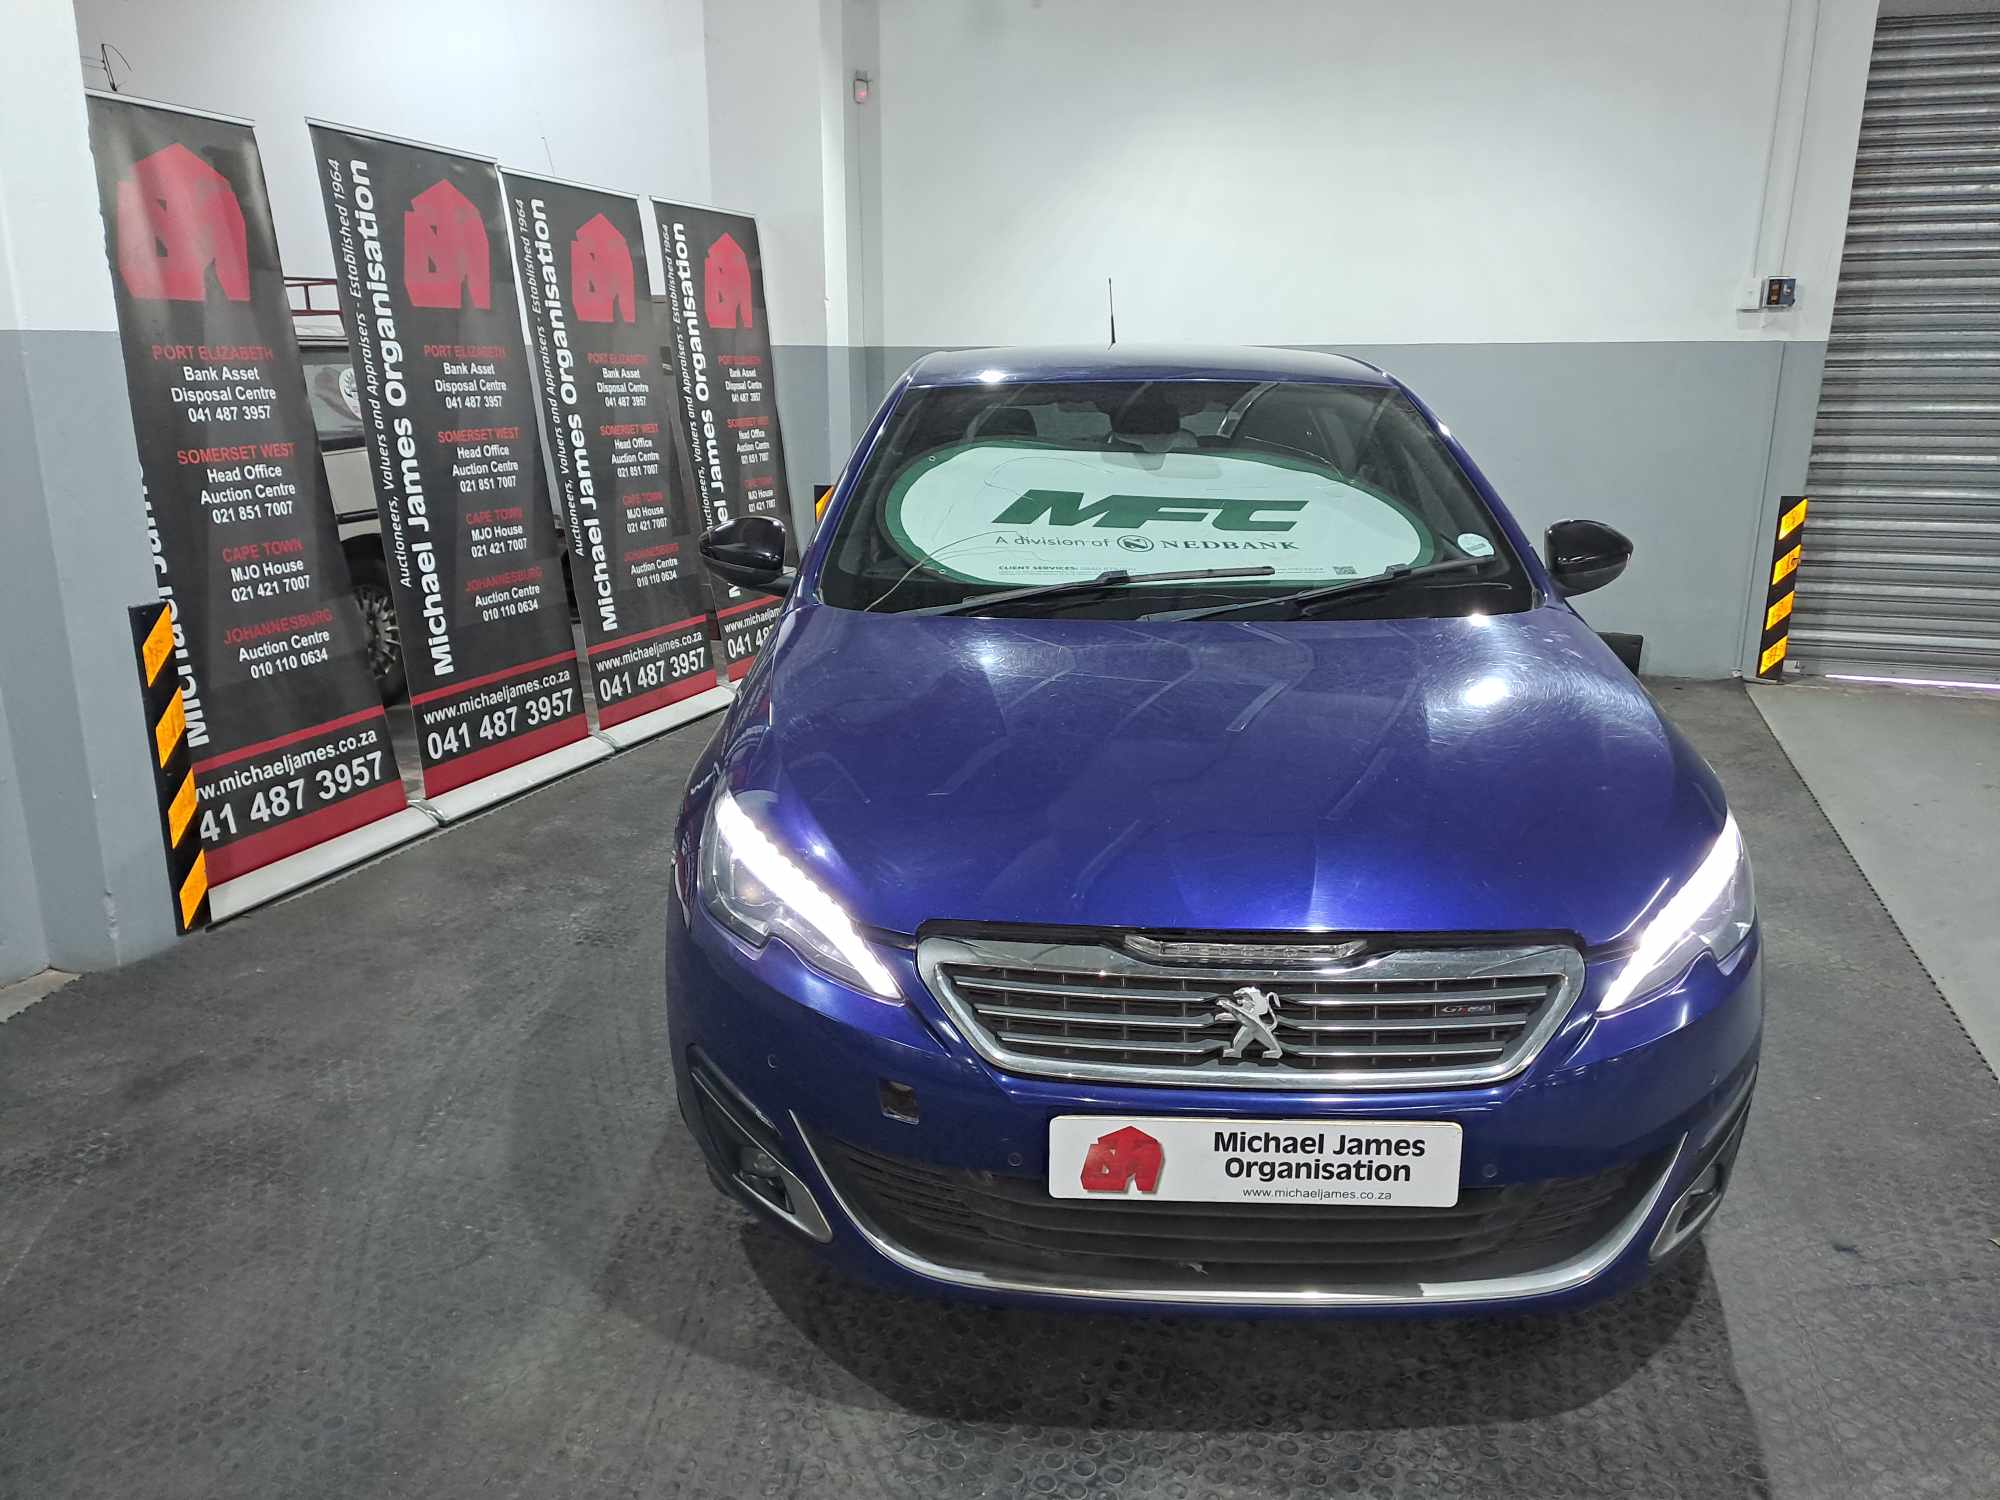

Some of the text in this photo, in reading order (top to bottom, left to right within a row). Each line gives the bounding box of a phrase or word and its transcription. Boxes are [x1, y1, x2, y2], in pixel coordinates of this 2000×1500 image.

[152, 345, 273, 361] PORT ELIZABETH
[673, 223, 725, 493] James Organisation
[677, 333, 693, 394] Appraisers
[183, 366, 259, 381] Bank Asset
[328, 158, 412, 588] Auctioneers, Valuers and Appraisers Established 1964
[443, 362, 495, 375] Bank Asset
[515, 198, 584, 556] Auctioneers, Valuers and Appraisers Established 1964
[171, 386, 276, 404] Disposal Centre
[434, 379, 507, 394] Disposal Centre
[188, 405, 271, 422] 041 487 3957
[445, 395, 502, 409] 041 487 3957
[686, 396, 697, 418] and
[350, 159, 455, 677] Michael James Organisation
[531, 198, 618, 632] Michael James Organisation
[437, 429, 493, 443] SOMERSET
[690, 421, 702, 463] Valuers
[177, 442, 296, 464] SOMERSET WEST
[456, 444, 510, 459] Head Office
[207, 464, 282, 483] Head Office
[452, 460, 519, 477] Auction Centre
[201, 483, 296, 505] Auction Centre
[460, 475, 517, 493] 021 851 7007
[212, 501, 293, 524] 021 851 7007
[992, 489, 1310, 531] MFC
[471, 525, 523, 542] MJO House
[995, 534, 1300, 551] A division of NEDBANK
[223, 538, 304, 562] CAPE TOWN
[471, 538, 527, 558] 021 421 7007
[230, 560, 304, 582] MJO House
[231, 575, 311, 602] 021 421 7007
[475, 585, 540, 607] Auction Centre
[482, 599, 539, 622] 010 110 0634
[224, 608, 334, 645] JOHANNESBURG
[239, 630, 330, 662] Auction Centre
[596, 630, 703, 672] www.michaeljames.co.za
[727, 623, 775, 658] 041 48
[250, 648, 328, 679] 010 110 0634
[600, 647, 705, 702] 041 487 3957
[423, 669, 571, 725] www.michaeljames.co.za
[427, 688, 573, 760] 041 487 3957
[196, 729, 378, 802] w.michaeljames.co.za
[200, 751, 383, 842] 41 487 3957
[1214, 1131, 1426, 1157] Michael James
[1225, 1156, 1411, 1182] Organisation
[1242, 1187, 1392, 1201] www.michaeljames.co.za
